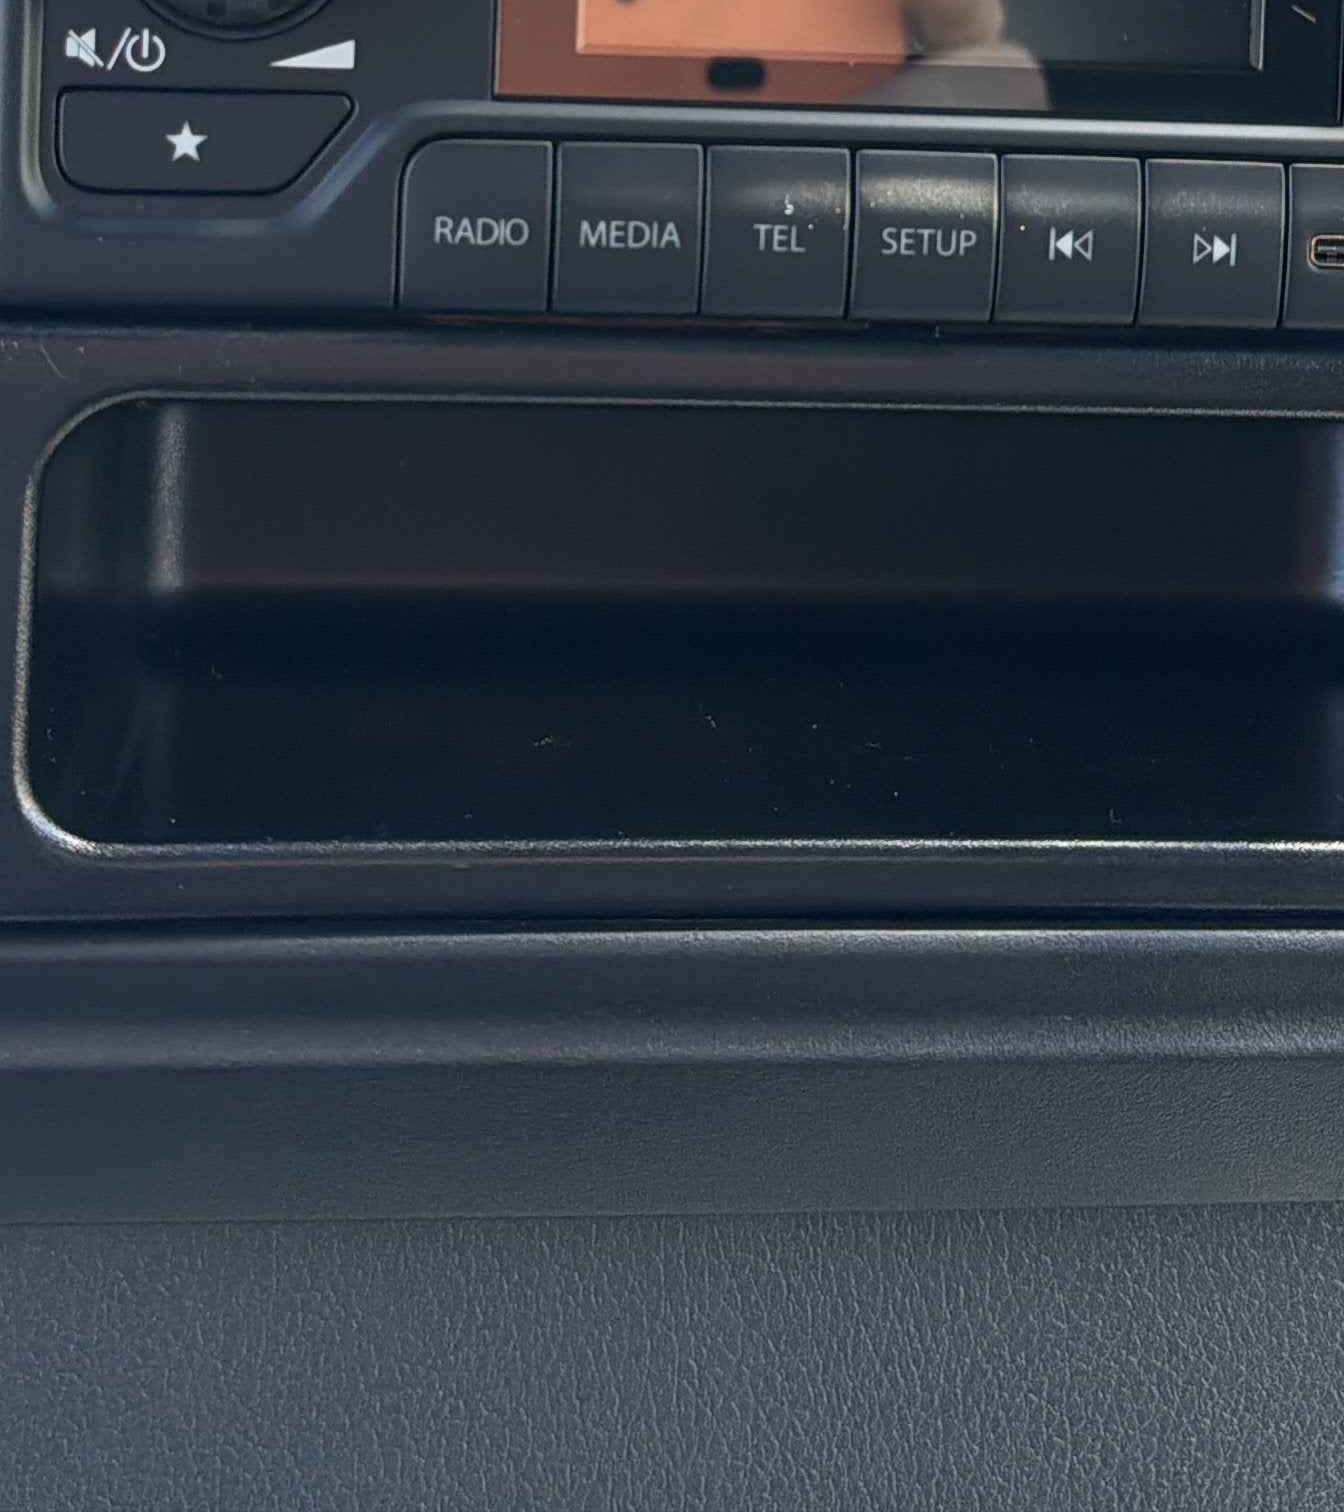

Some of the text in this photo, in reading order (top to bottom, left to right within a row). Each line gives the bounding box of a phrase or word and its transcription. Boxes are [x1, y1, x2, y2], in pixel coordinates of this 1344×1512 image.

[433, 216, 530, 247] RADIO
[579, 219, 682, 250] MEDIA
[754, 223, 806, 253] TEL
[880, 227, 978, 257] SETUP
